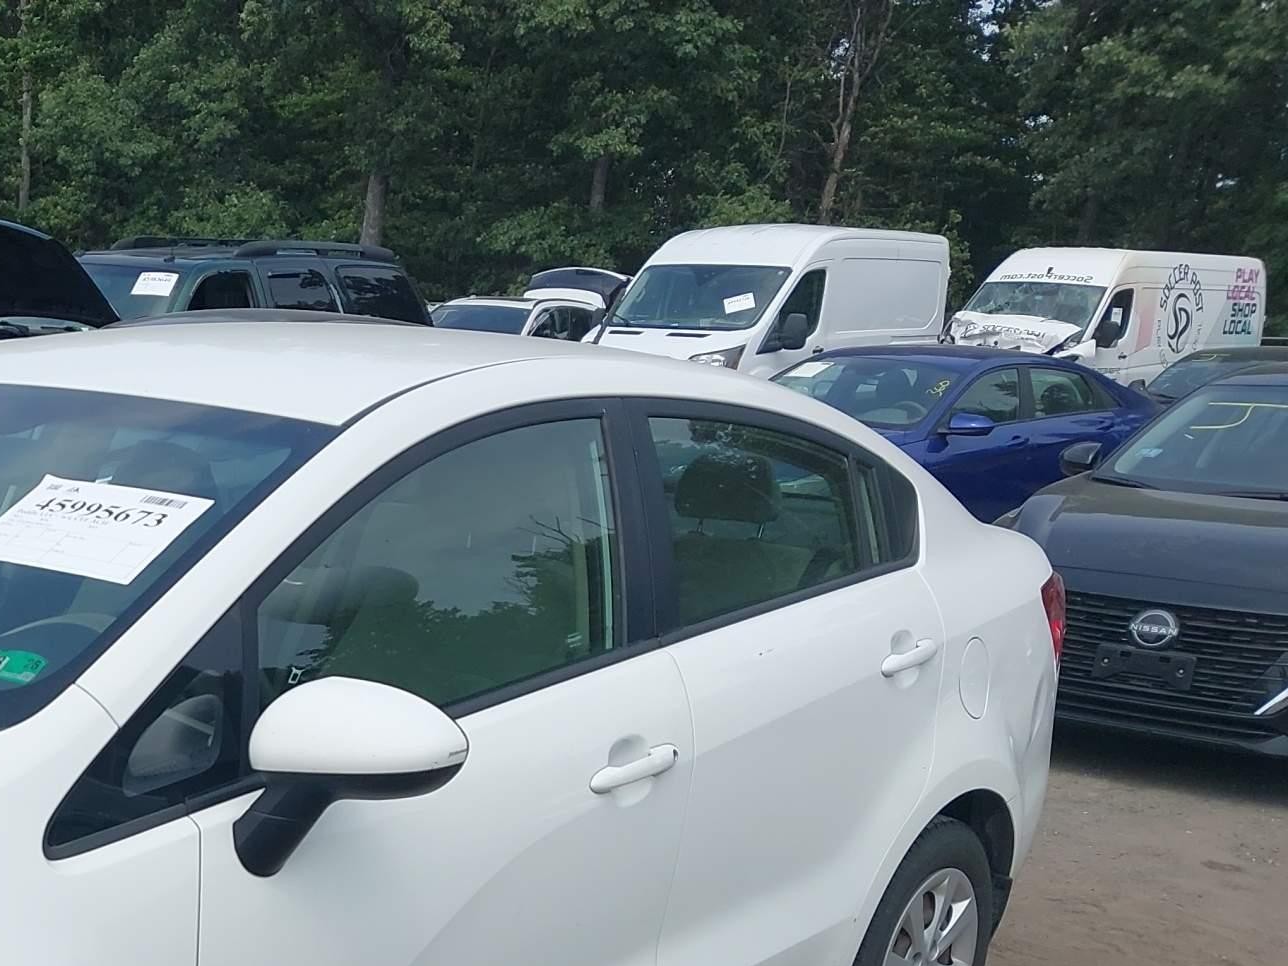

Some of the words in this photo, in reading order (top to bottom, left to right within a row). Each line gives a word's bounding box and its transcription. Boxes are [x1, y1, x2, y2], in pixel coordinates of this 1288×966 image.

[1235, 268, 1260, 283] PLAY
[1160, 263, 1190, 312] SOCCER
[1190, 271, 1204, 313] POST
[1226, 284, 1256, 300] LOCAL
[1231, 303, 1257, 318] SHOP
[1222, 319, 1252, 335] LOCAL
[35, 497, 169, 528] 45995673
[1130, 623, 1178, 636] NISSAN
